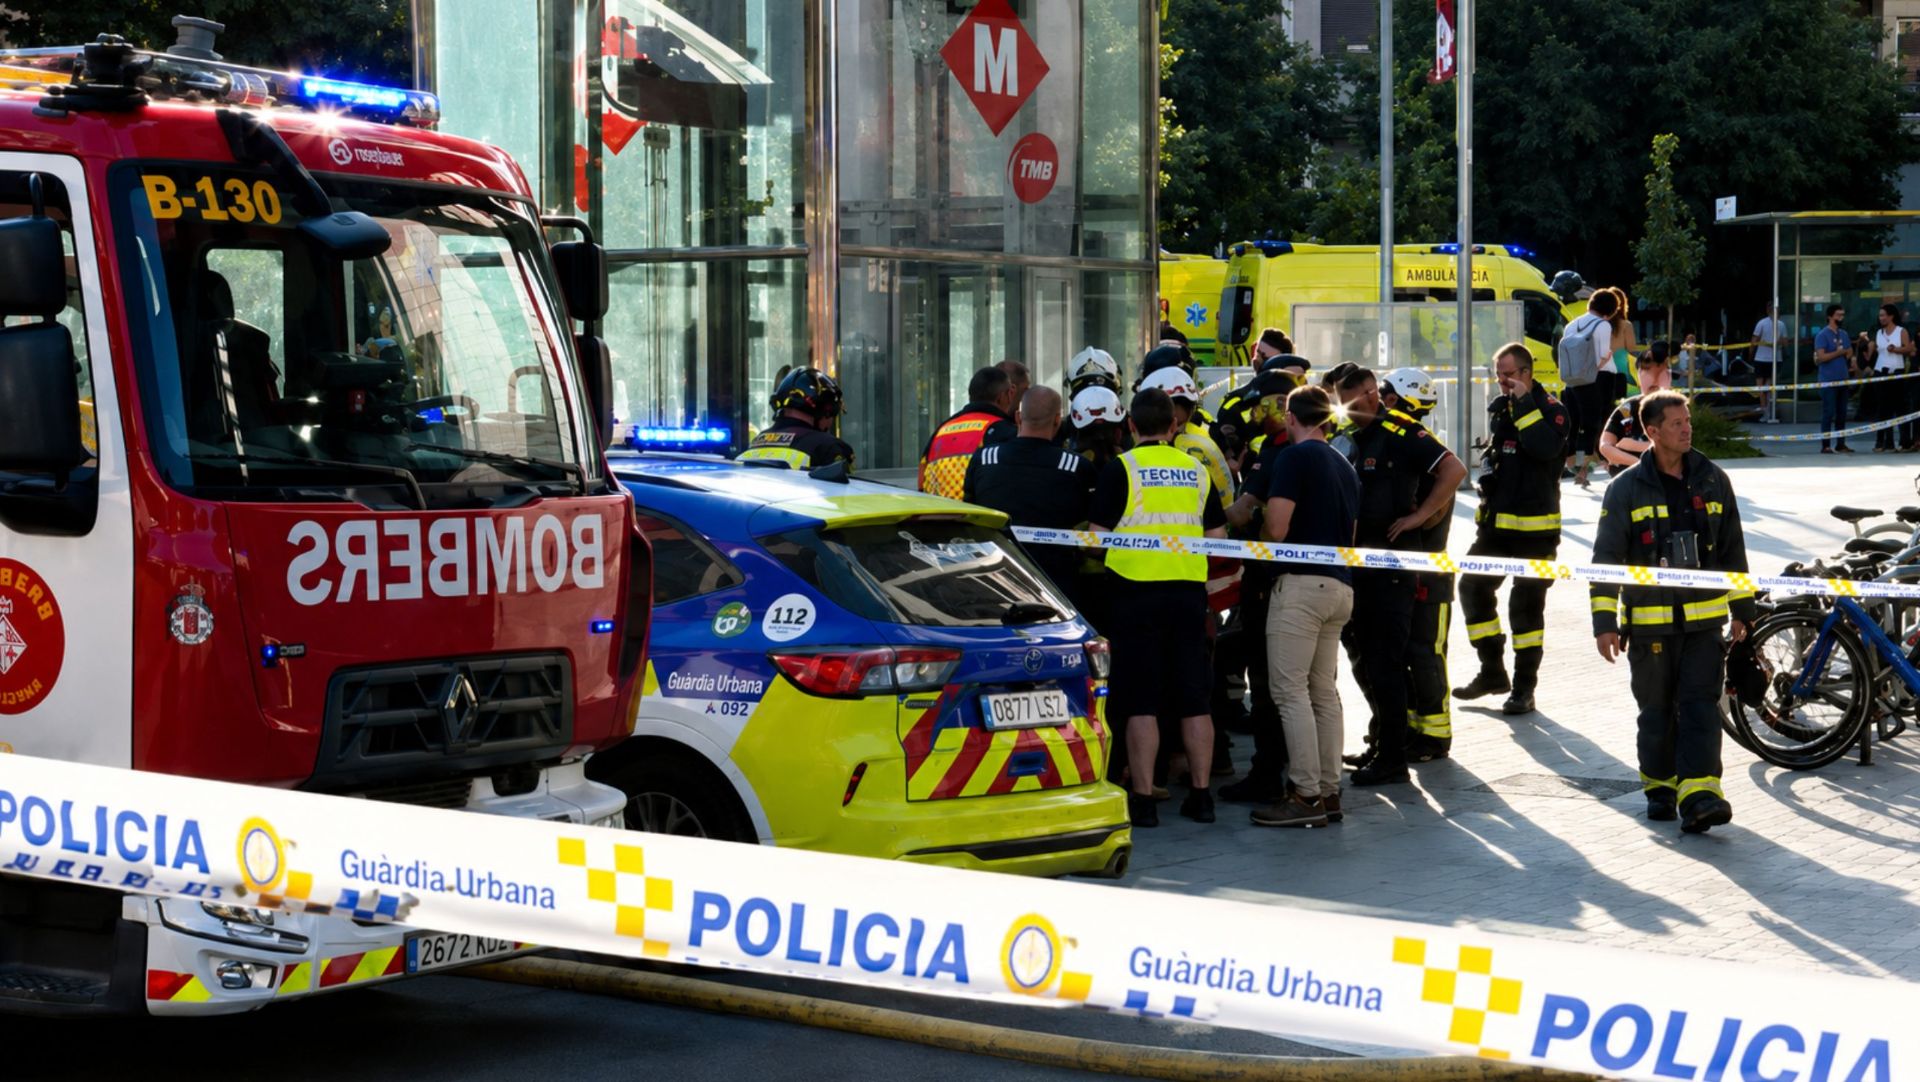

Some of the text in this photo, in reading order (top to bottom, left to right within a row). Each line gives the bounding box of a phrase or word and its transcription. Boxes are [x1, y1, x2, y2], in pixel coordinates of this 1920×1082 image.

[973, 21, 1019, 97] M
[1020, 158, 1054, 181] TMB
[141, 174, 282, 225] B-130
[1137, 468, 1198, 482] TECNIC
[771, 606, 808, 625] 112
[668, 671, 763, 695] Guàrdia Urbana
[720, 701, 749, 717] 092
[993, 693, 1065, 723] 0877 LSZ
[340, 848, 556, 910] Guàrdia Urbana
[421, 933, 470, 966] 2672
[687, 889, 970, 985] POLICIA
[1129, 946, 1384, 1013] Guàrdia Urbana
[1530, 993, 1892, 1082] POLICIA
